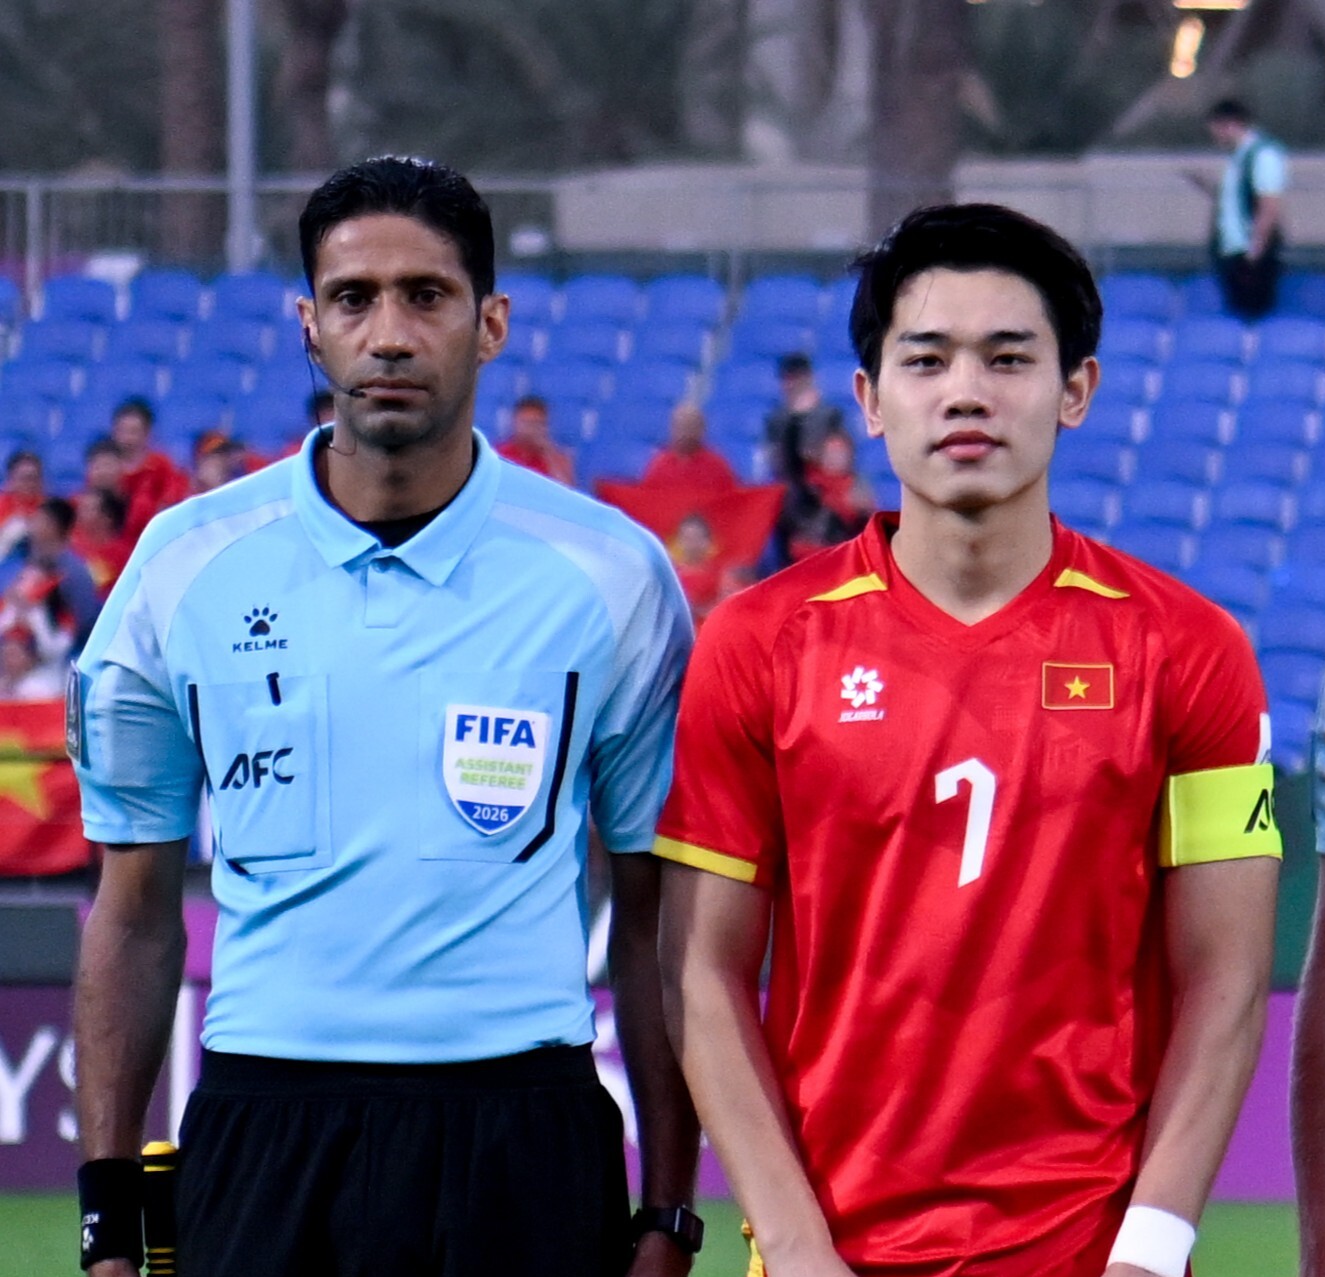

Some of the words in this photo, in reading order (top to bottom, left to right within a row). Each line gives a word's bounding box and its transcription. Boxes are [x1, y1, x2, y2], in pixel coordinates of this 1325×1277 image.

[232, 639, 288, 654] KELME
[455, 714, 536, 748] FIFA
[219, 747, 295, 791] AFC
[455, 757, 534, 776] ASSISTANT
[460, 772, 527, 790] REFEREE
[473, 805, 510, 823] 2026
